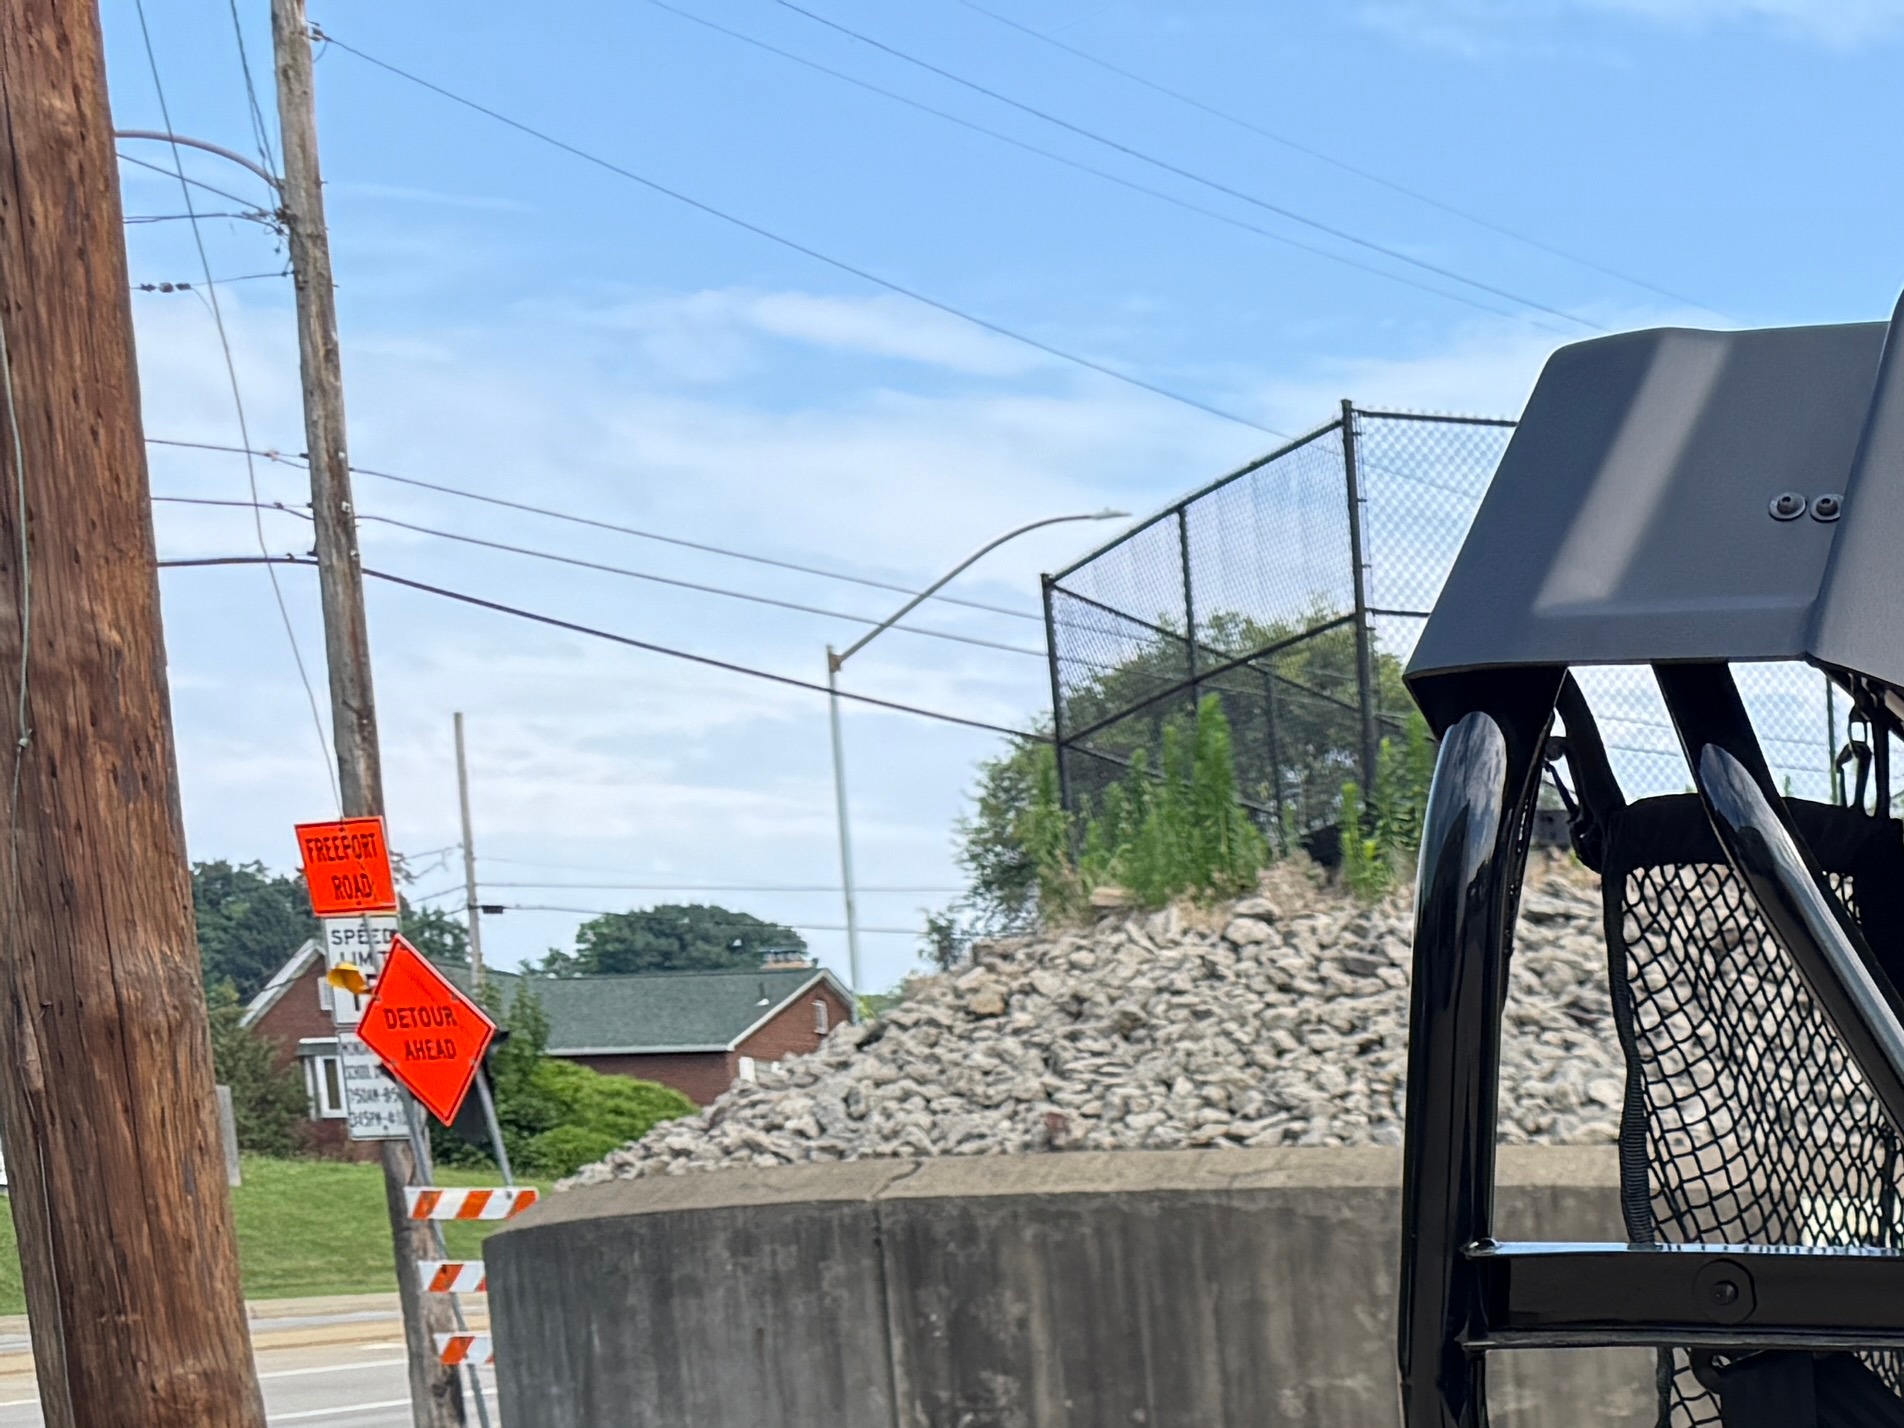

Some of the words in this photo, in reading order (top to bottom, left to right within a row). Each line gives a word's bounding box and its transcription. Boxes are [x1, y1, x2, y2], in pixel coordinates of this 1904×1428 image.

[305, 833, 377, 864] FREEPORT
[331, 873, 372, 900] ROAD
[331, 928, 397, 945] SPEED
[383, 1005, 458, 1030] DETOUR
[405, 1039, 457, 1061] AHEAD
